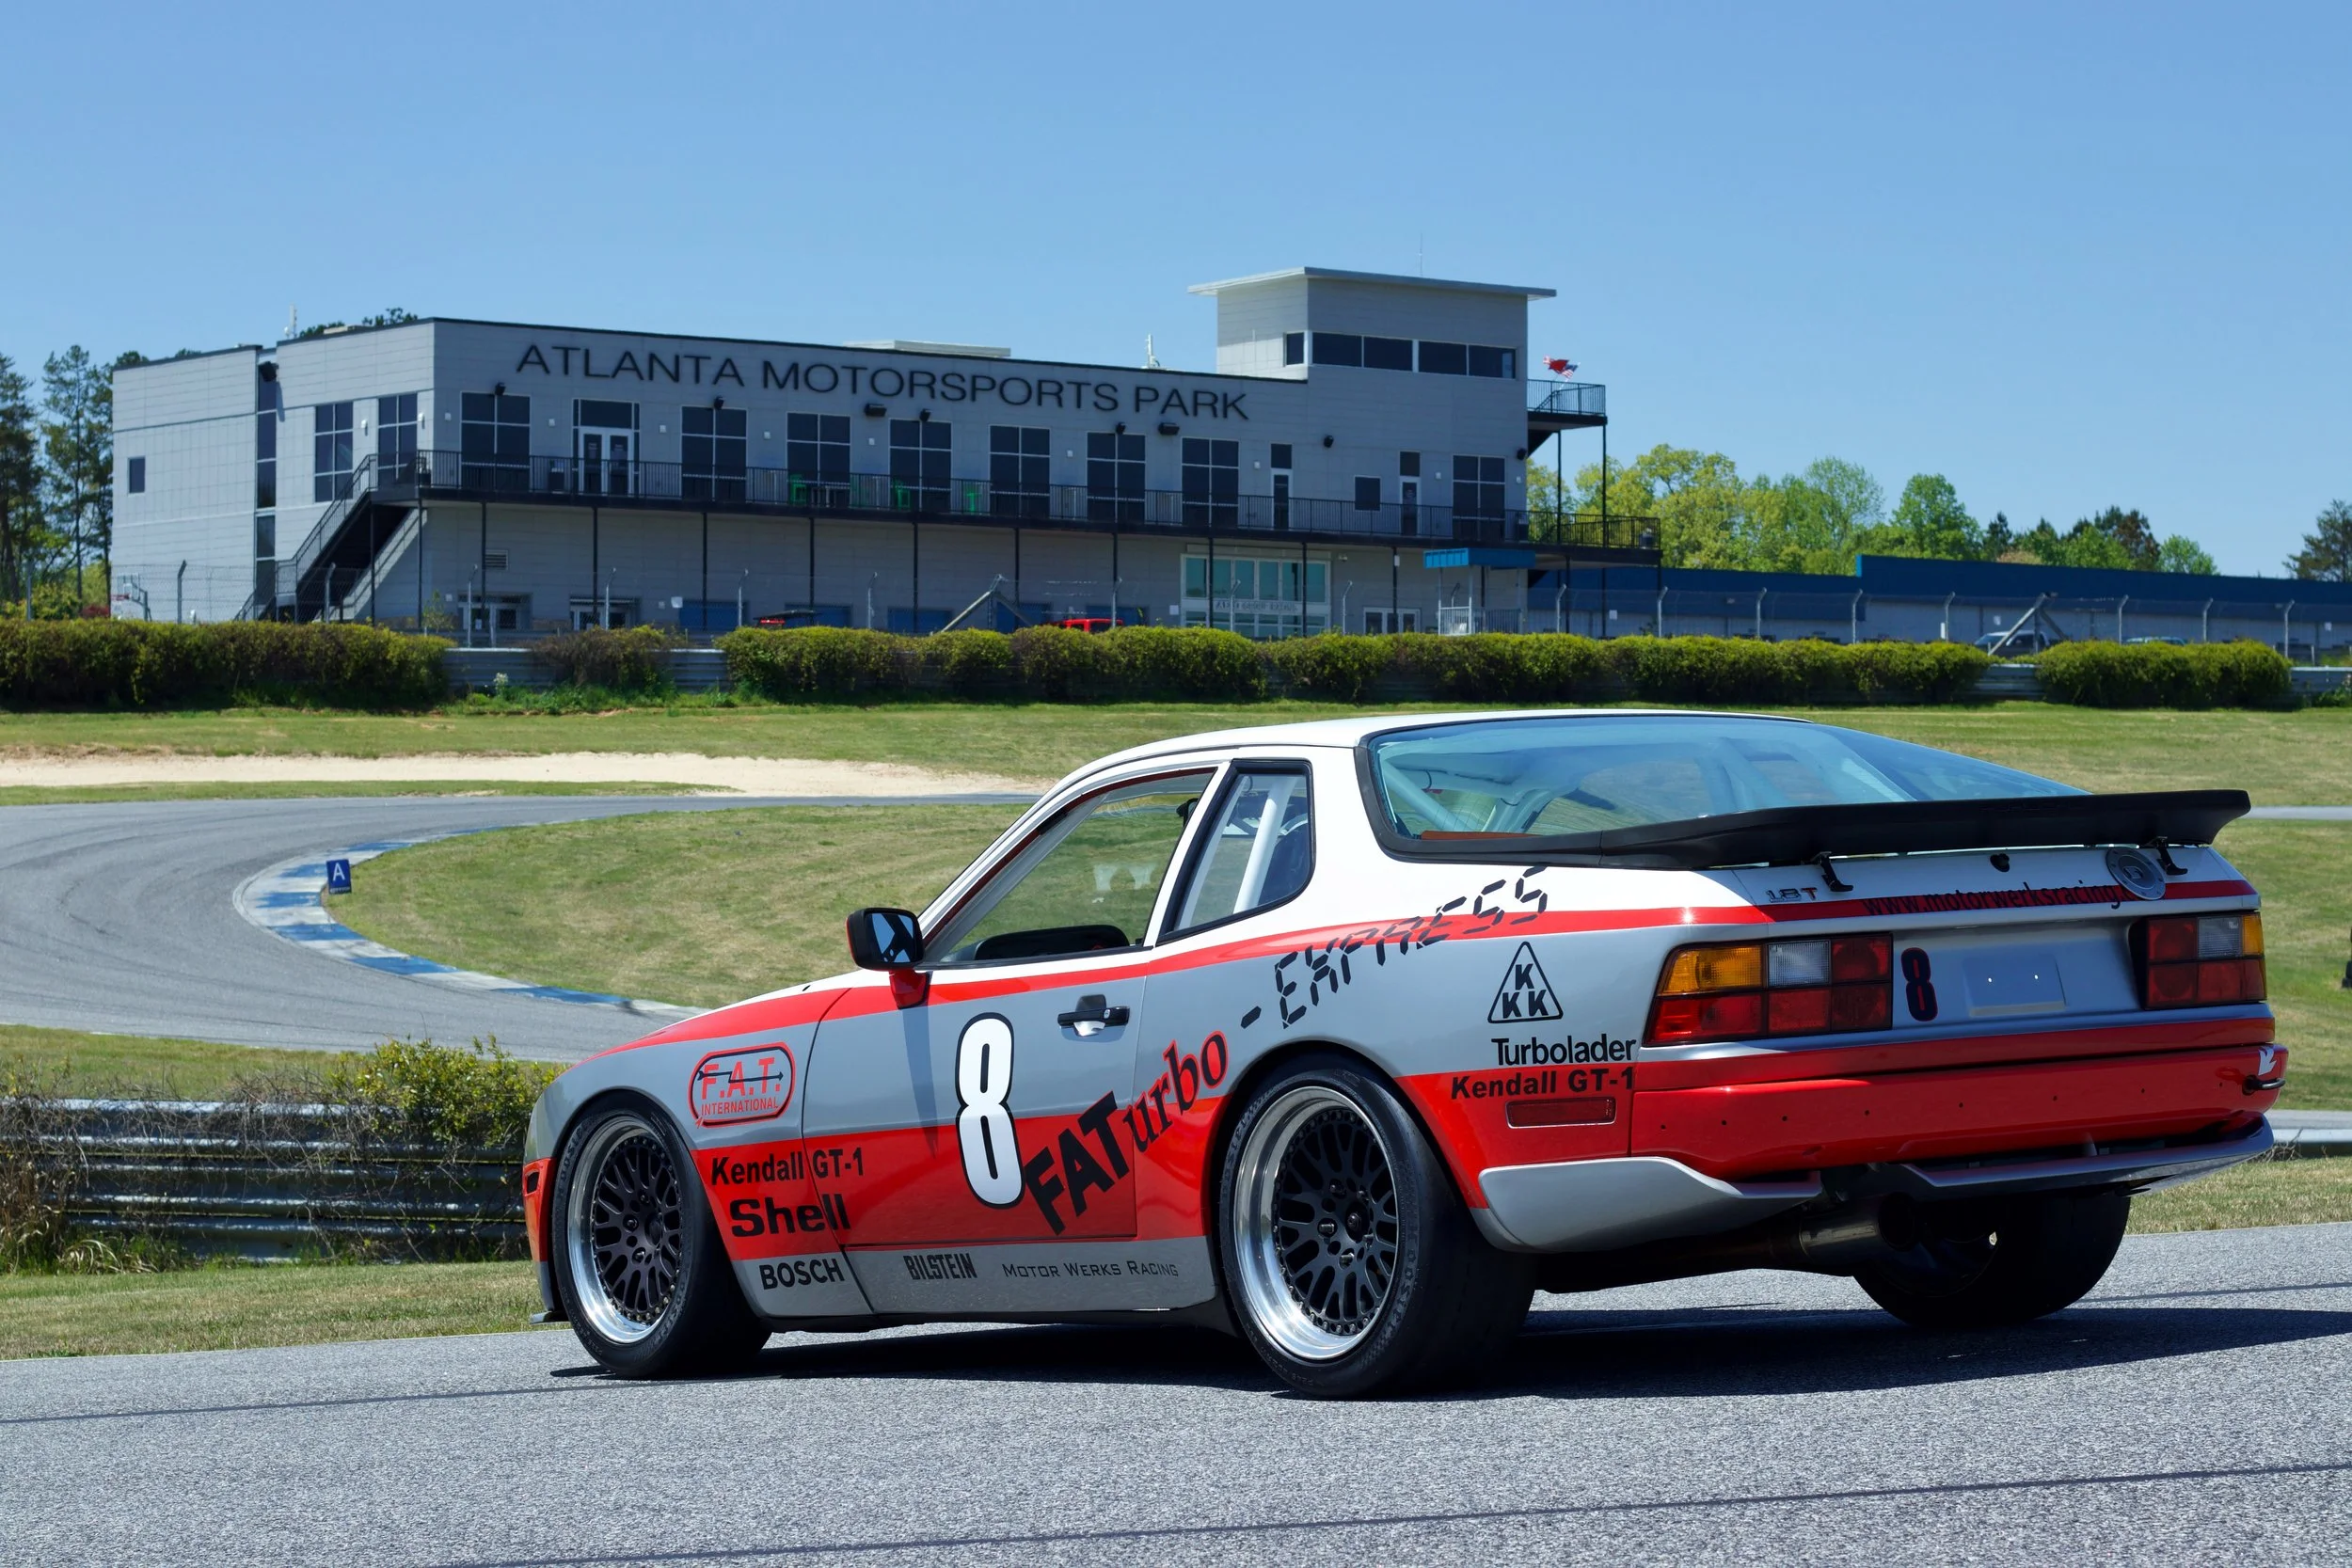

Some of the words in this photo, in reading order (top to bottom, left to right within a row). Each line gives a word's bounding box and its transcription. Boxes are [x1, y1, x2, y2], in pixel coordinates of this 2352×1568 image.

[516, 343, 745, 388] ATLANTA
[763, 359, 1119, 413] MOTORSPORTS
[1135, 386, 1250, 420] PARK
[333, 862, 346, 881] A
[1900, 947, 1938, 1022] 8
[1491, 1034, 1637, 1066] Turbolader
[1451, 1070, 1557, 1100] Kendall
[1568, 1067, 1634, 1093] GT-1
[701, 1097, 779, 1116] INTERNATIONAL
[955, 1012, 1025, 1210] 8
[711, 1151, 804, 1186] Kendall
[812, 1147, 865, 1179] GT-1
[729, 1193, 851, 1238] Shell
[759, 1259, 845, 1290] BOSCH
[903, 1252, 977, 1280] BILSTEIN
